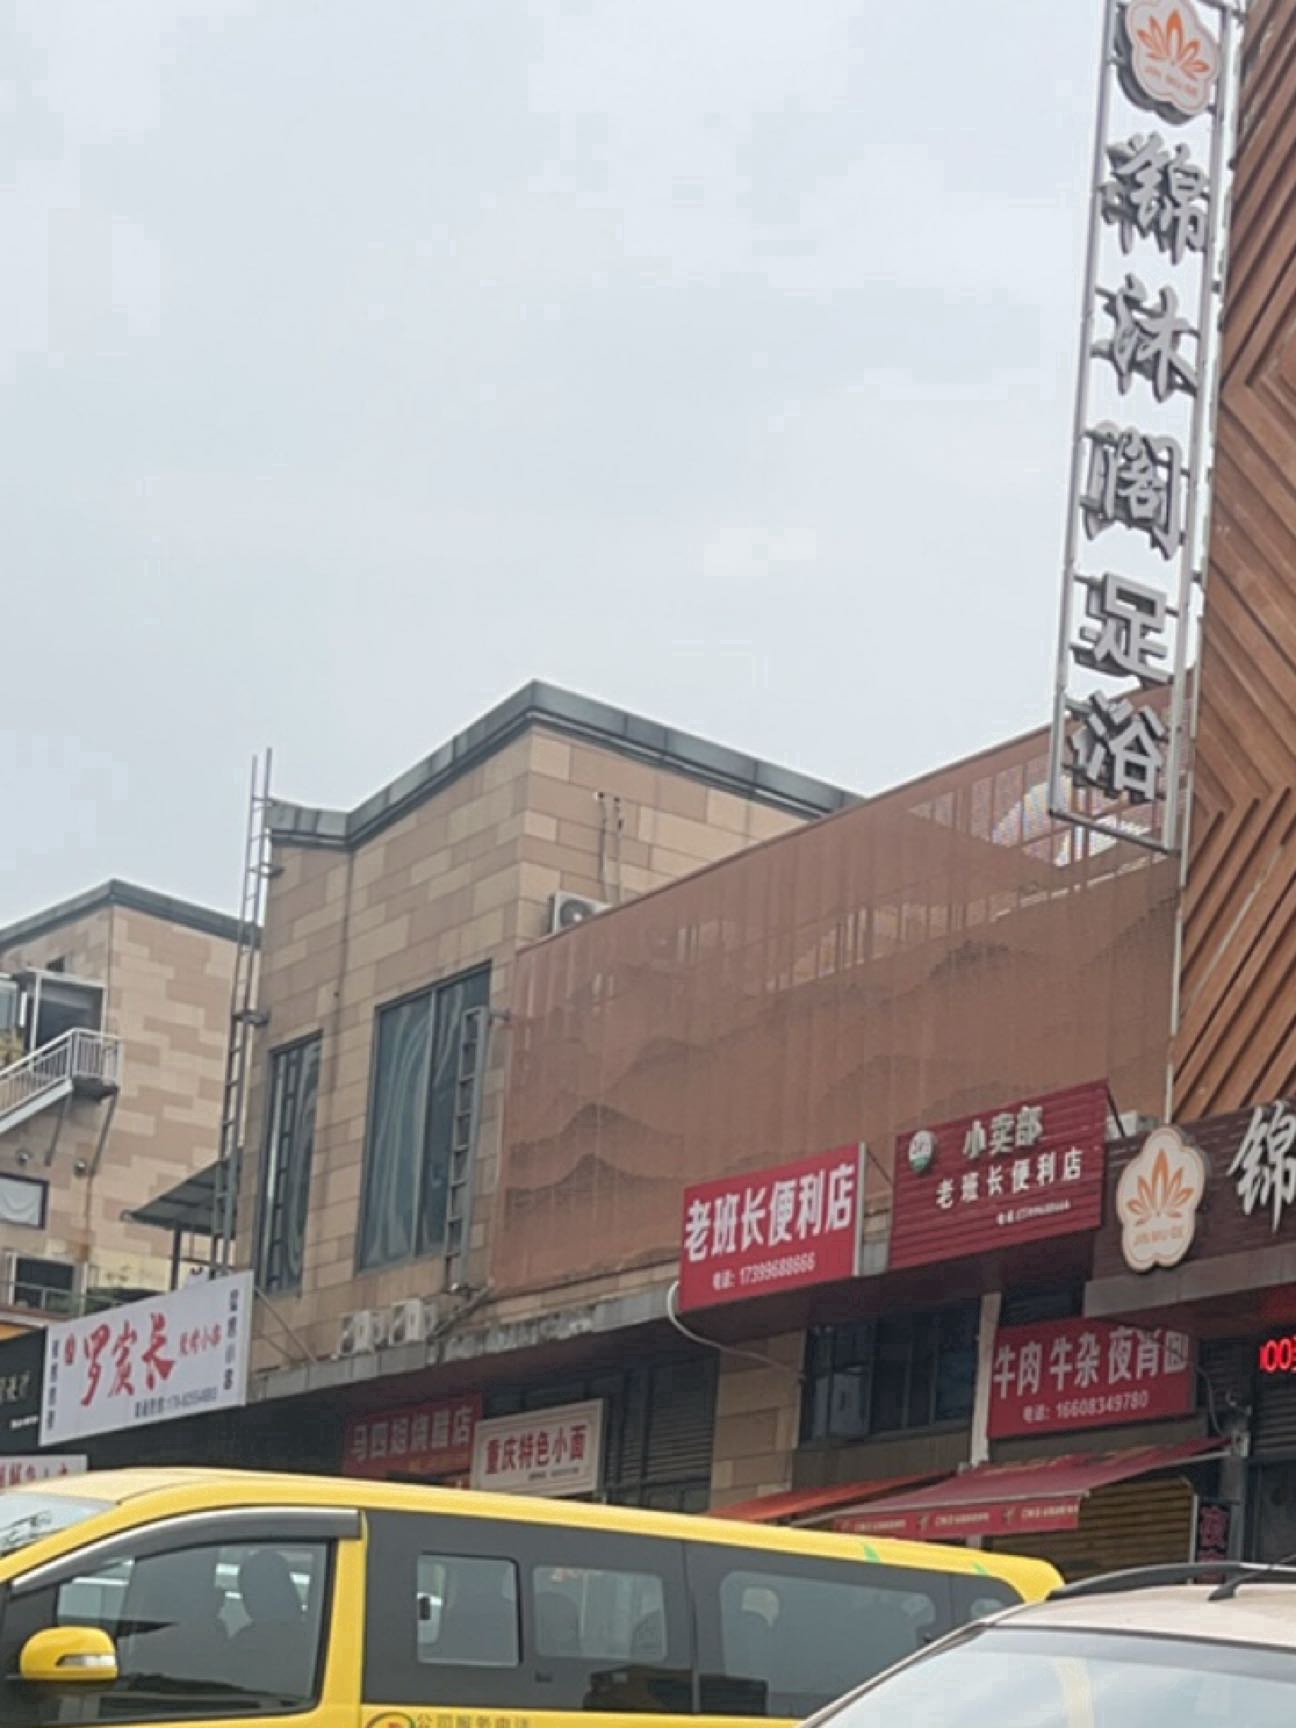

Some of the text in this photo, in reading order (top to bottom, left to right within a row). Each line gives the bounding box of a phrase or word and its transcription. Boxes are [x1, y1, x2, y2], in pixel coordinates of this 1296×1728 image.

[684, 1163, 856, 1263] 老班长便利店
[485, 1424, 588, 1475] 重庆特色小面
